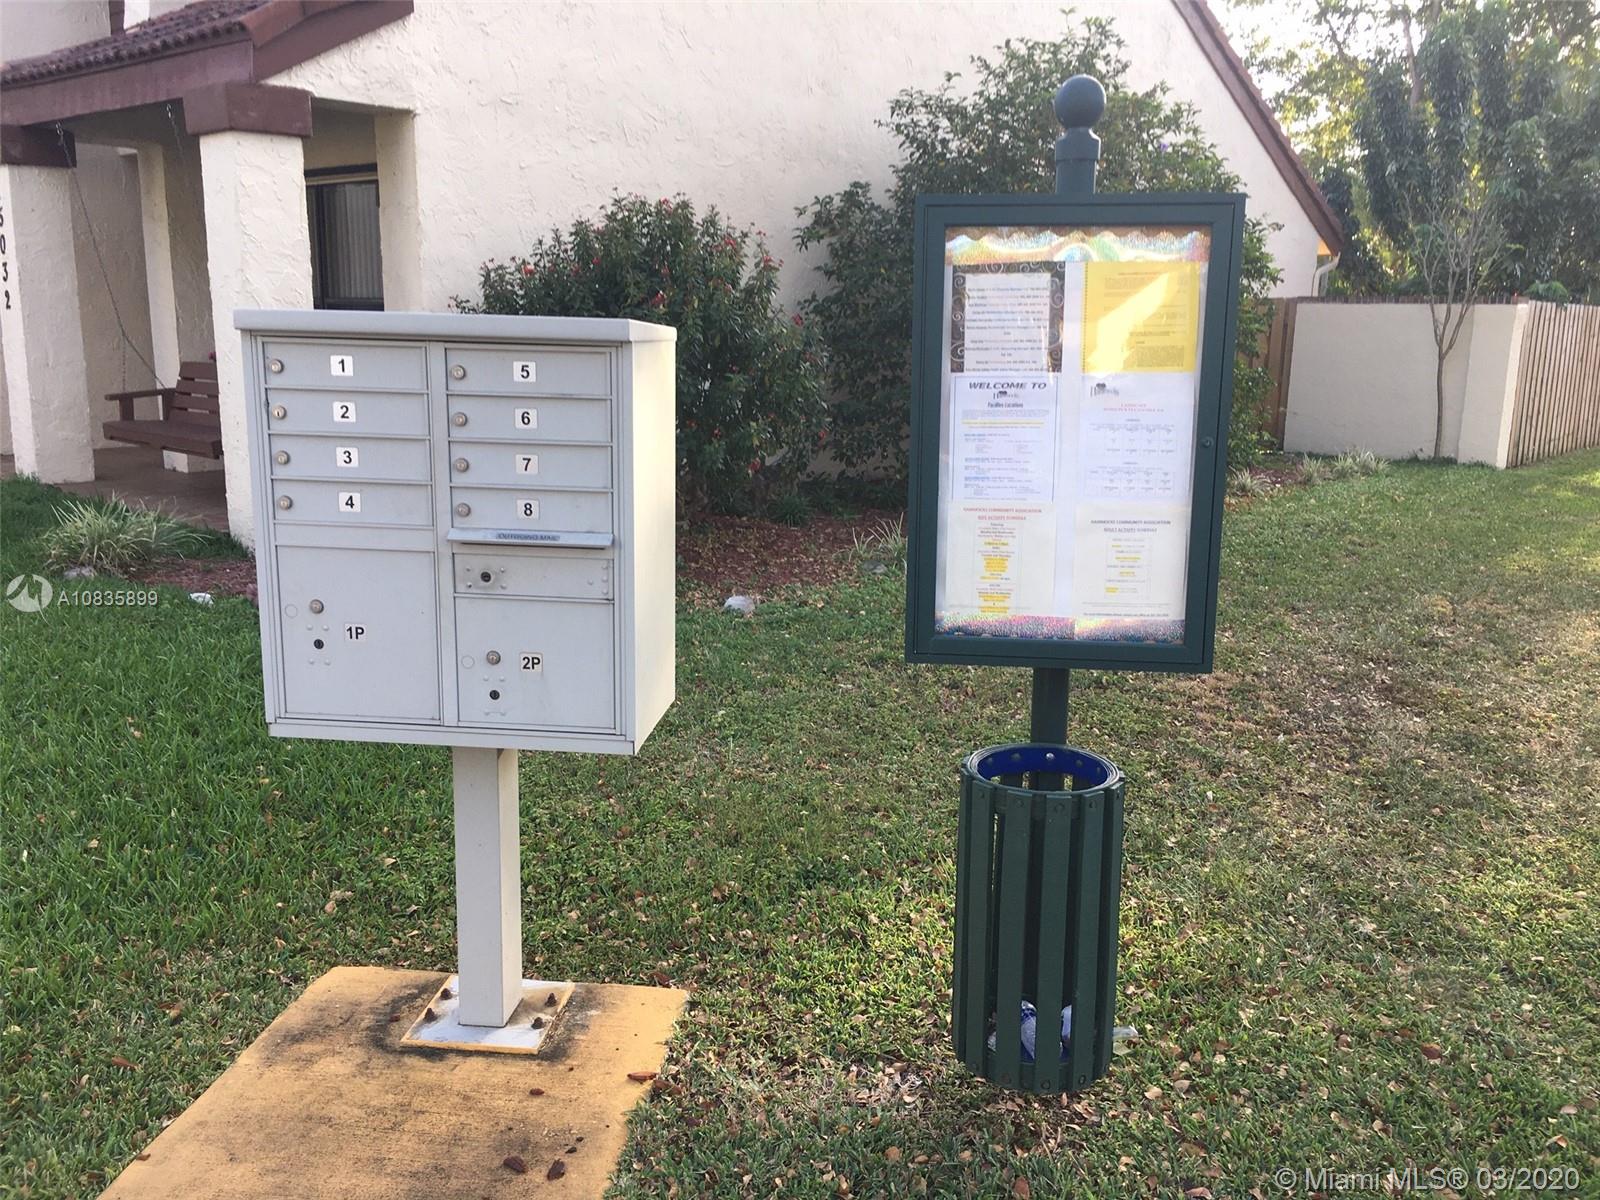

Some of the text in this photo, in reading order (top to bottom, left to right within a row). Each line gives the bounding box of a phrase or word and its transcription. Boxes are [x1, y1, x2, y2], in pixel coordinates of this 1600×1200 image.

[337, 358, 346, 373] 1
[520, 364, 530, 379] 5
[969, 382, 1047, 390] WELCOME TO
[340, 404, 350, 419] 2
[521, 411, 531, 425] 6
[343, 450, 352, 464] 3
[522, 457, 531, 472] 7
[345, 495, 355, 509] 4
[523, 502, 533, 517] 8
[346, 626, 365, 640] 1P
[522, 656, 541, 670] 2P
